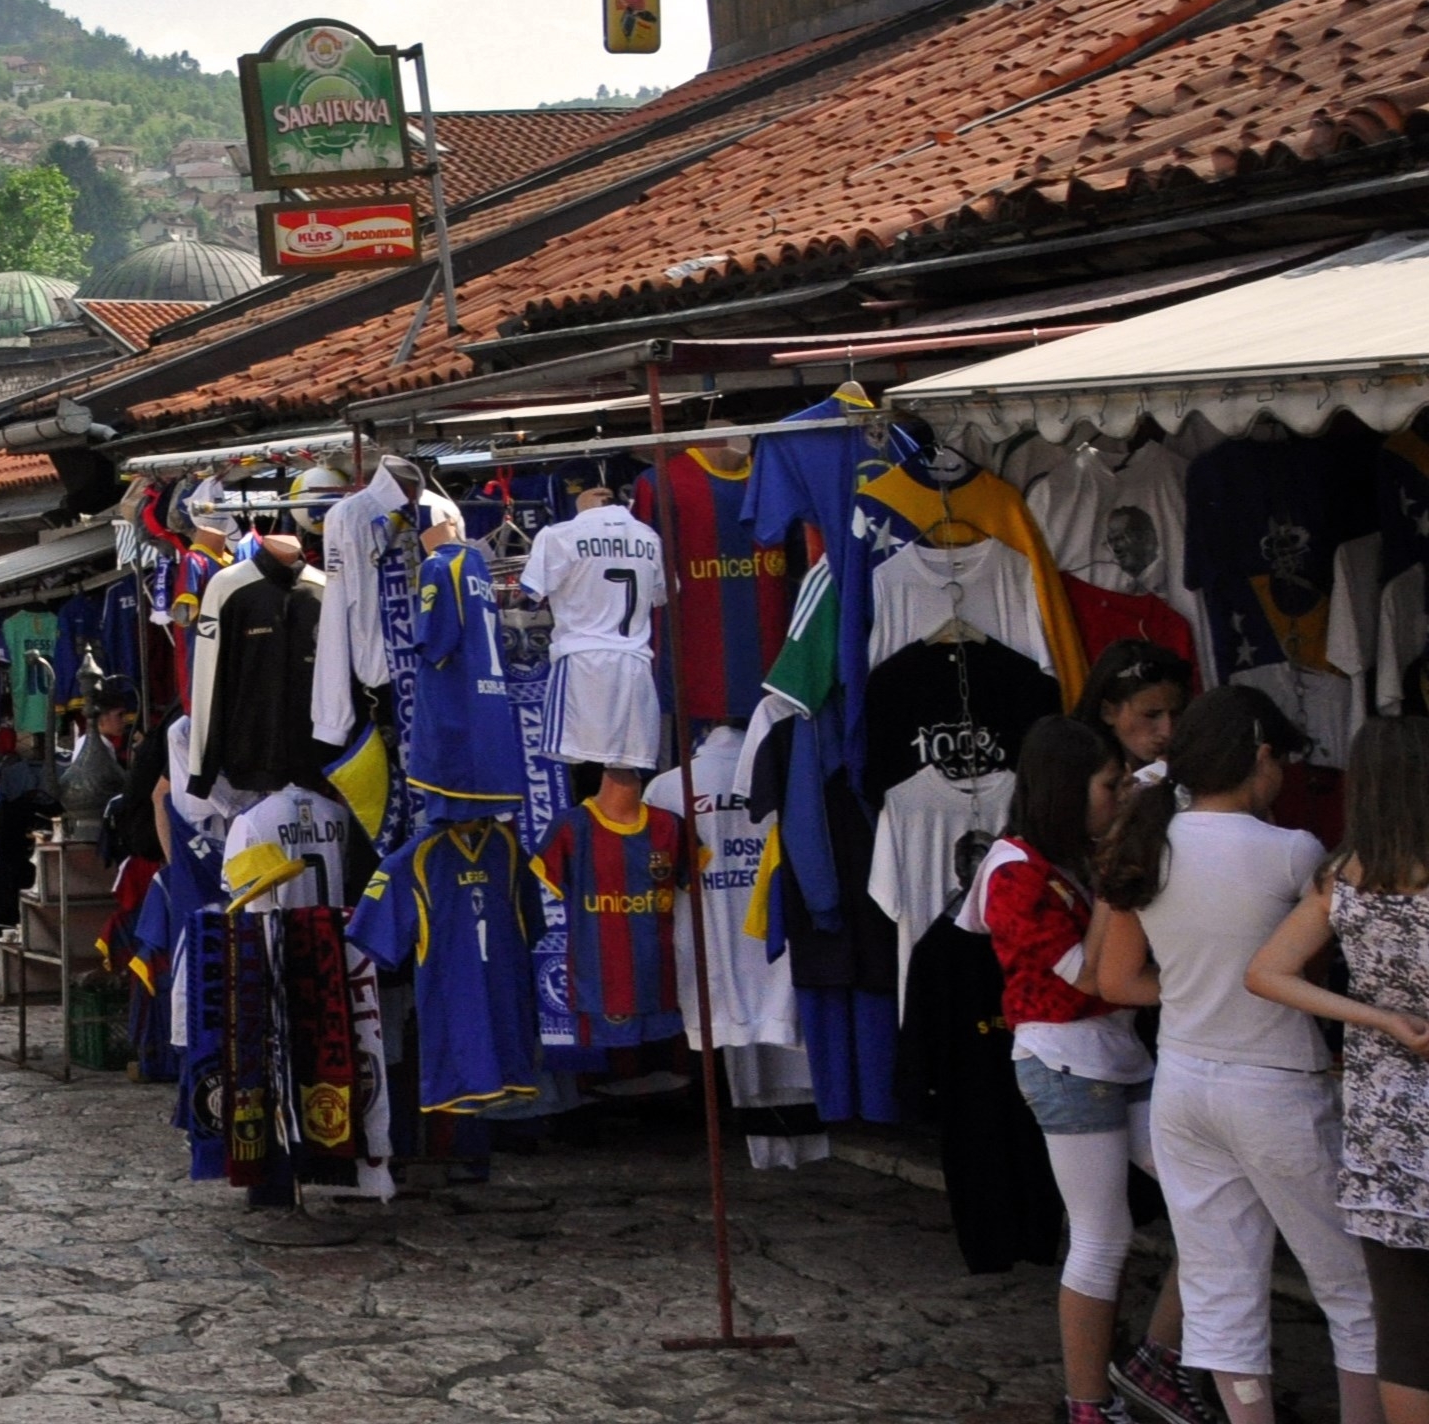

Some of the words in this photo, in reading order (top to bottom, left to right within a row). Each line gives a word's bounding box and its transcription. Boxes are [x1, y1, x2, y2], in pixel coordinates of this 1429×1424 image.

[273, 98, 392, 134] SARAJEVSKA
[297, 231, 334, 244] KLAS
[576, 538, 656, 561] RONALDO
[689, 552, 762, 579] unicef
[603, 568, 638, 638] 7
[583, 890, 654, 914] unicef
[476, 919, 489, 962] 1
